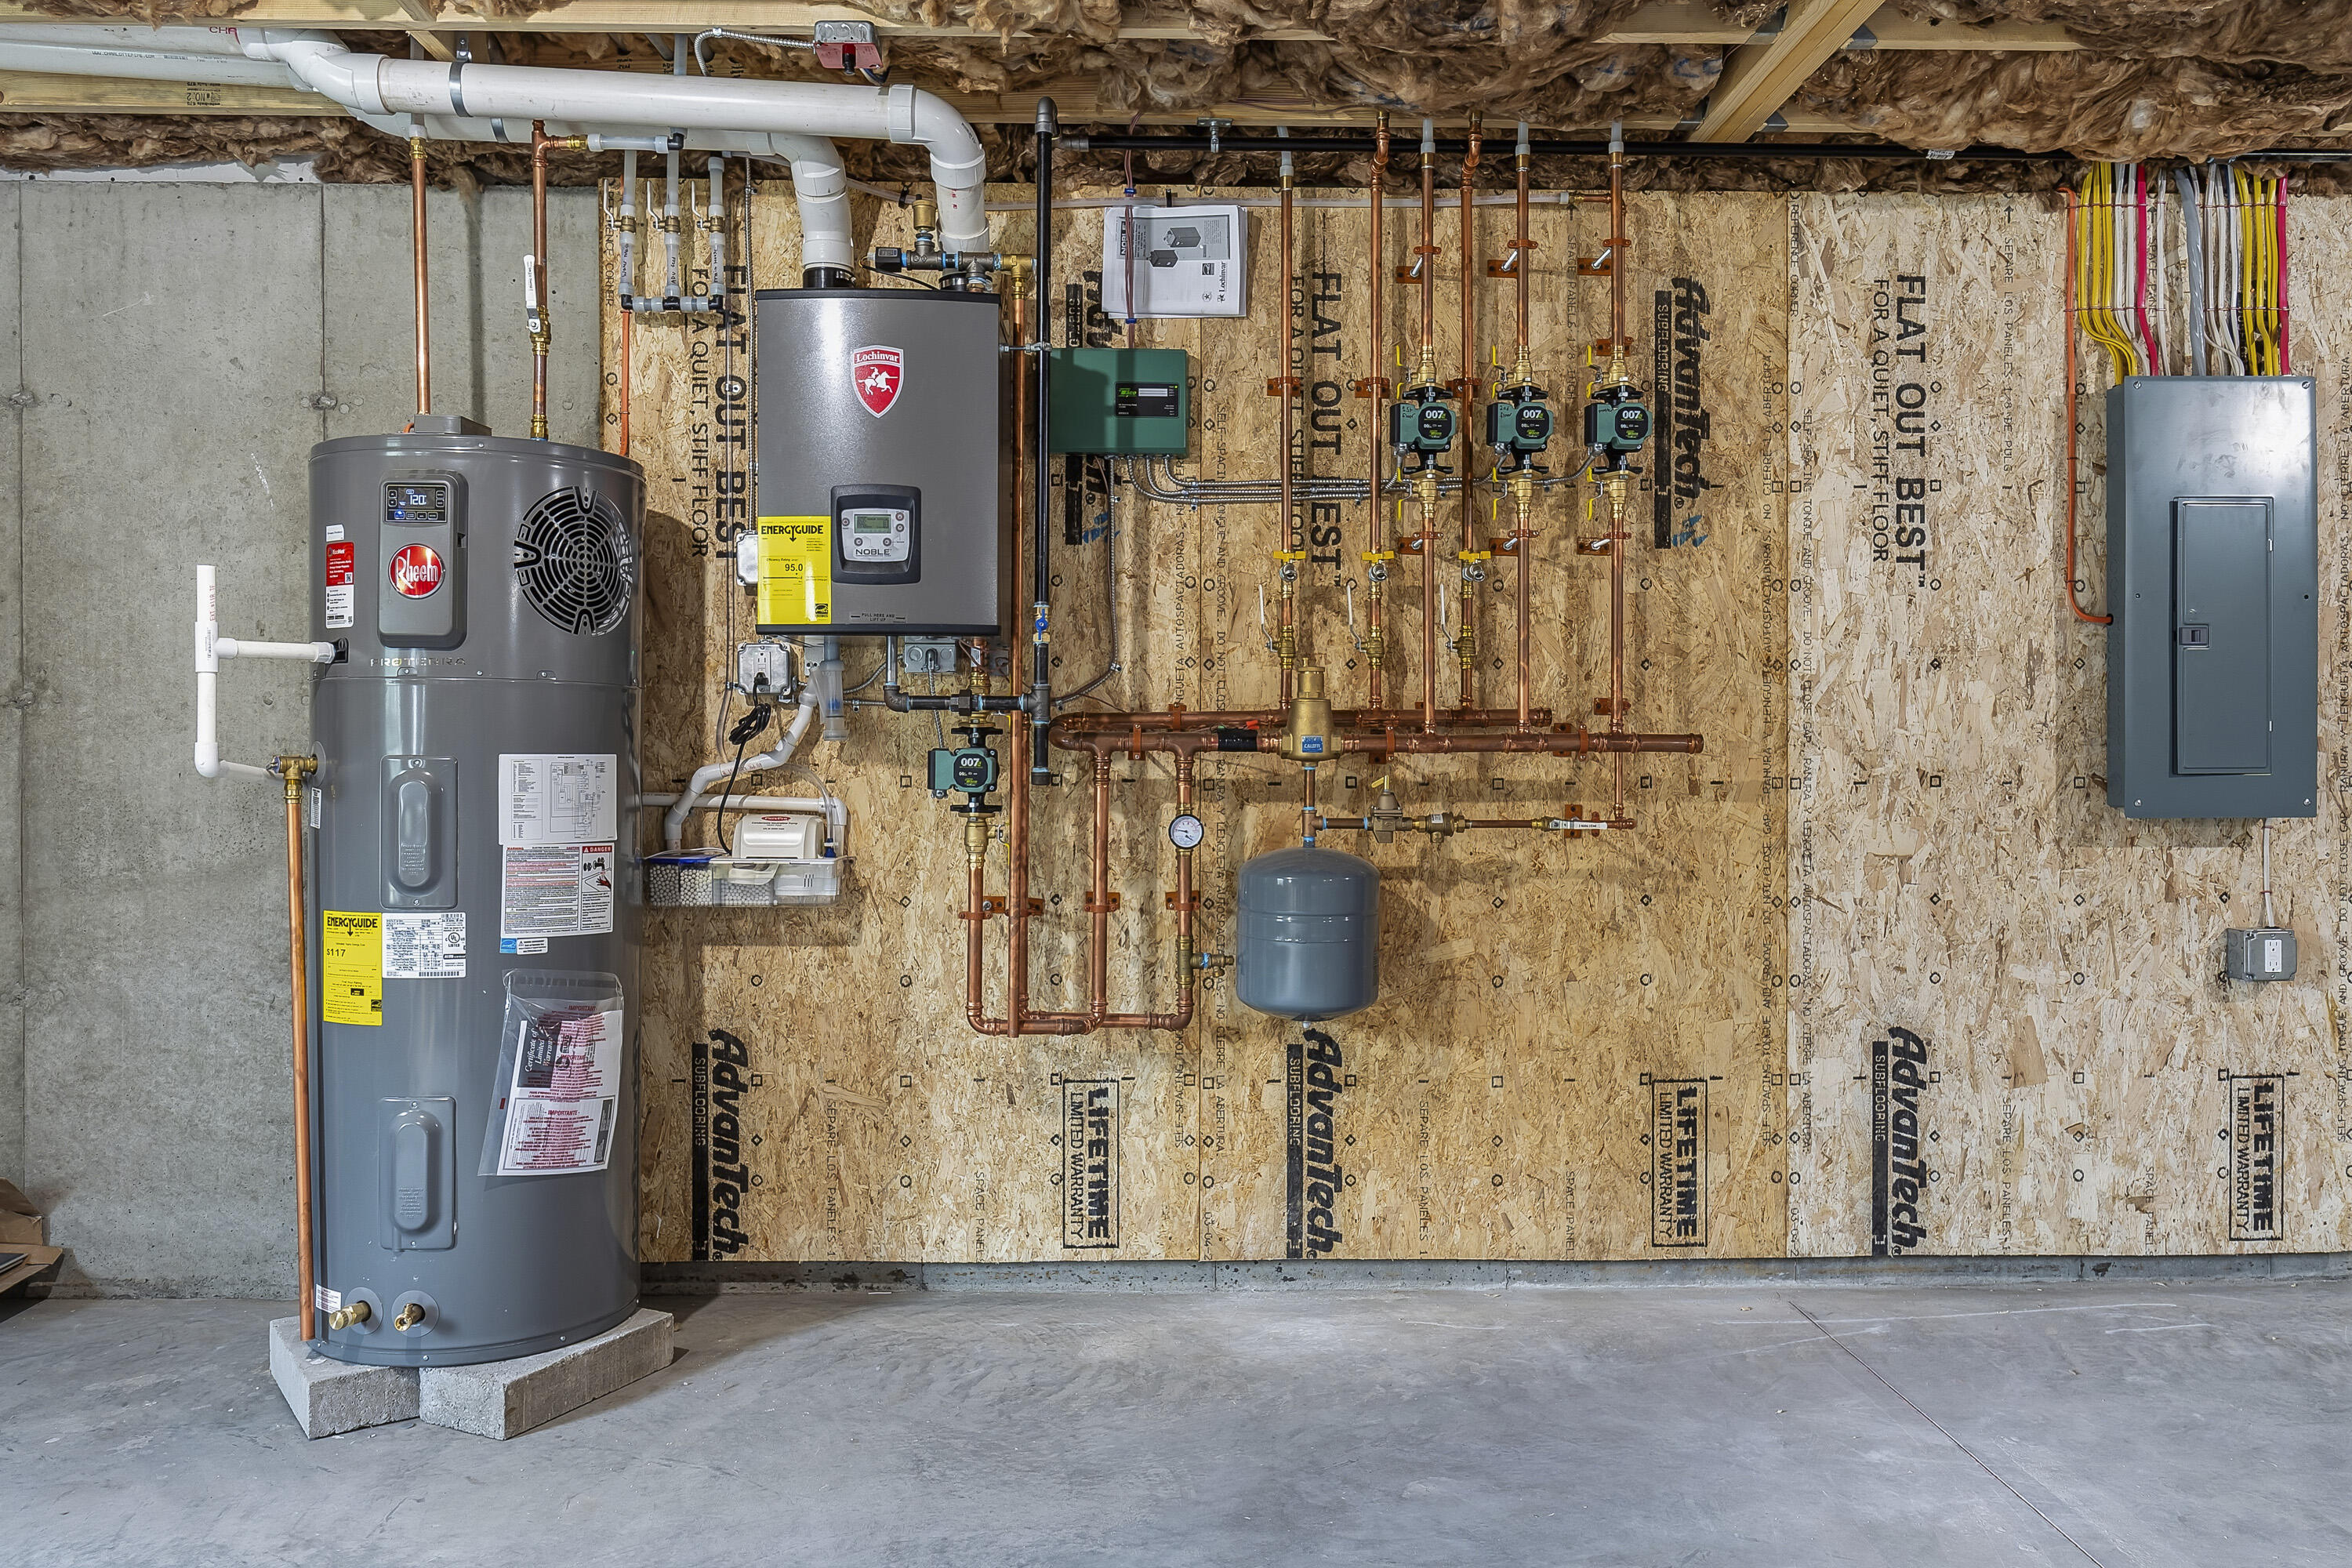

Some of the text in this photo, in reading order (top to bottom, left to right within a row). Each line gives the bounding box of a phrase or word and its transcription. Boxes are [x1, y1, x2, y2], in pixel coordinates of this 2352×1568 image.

[187, 93, 191, 102] 2
[1567, 235, 1577, 271] SPACE
[1790, 204, 1799, 268] REFERENCE
[2148, 237, 2157, 276] SPACE
[1218, 261, 1227, 292] Lochinvar
[2002, 237, 2013, 283] SEPARE
[604, 263, 614, 307] CORNER
[2002, 292, 2013, 315] LOS
[856, 351, 899, 362] Lochinvar
[1311, 271, 1342, 458] FLAT OUT
[1656, 304, 1670, 392] SUBFLOORING
[1895, 274, 1926, 458] FLAT OUT
[2002, 323, 2013, 378] PANELES
[1567, 370, 1577, 399] INCH
[715, 376, 746, 450] OUT
[1871, 279, 1889, 563] FOR A QUIET, STIFF FLOOR
[2002, 417, 2013, 433] DE
[690, 318, 708, 558] A QUIET, STIFF FLOOR
[1217, 406, 1226, 481] SELF-SPACIN
[2002, 441, 2013, 472] PULG
[1762, 450, 1772, 495] CIERRE
[2339, 450, 2349, 495] CIERRE
[760, 525, 824, 535] ENERGYGUIDE
[1217, 504, 1226, 540] ONGUE
[1762, 504, 1772, 519] NO
[1803, 500, 1812, 541] TONGUE
[2339, 503, 2349, 519] NO
[395, 549, 438, 590] Rheem
[785, 563, 803, 572] 95.0
[1217, 547, 1226, 569] AND
[1803, 548, 1812, 569] AND
[1217, 630, 1226, 646] DO
[1803, 630, 1812, 646] DO
[1217, 652, 1226, 673] NOT
[1803, 652, 1812, 673] NOT
[1762, 658, 1772, 723] LENGUETA
[1803, 681, 1812, 716] CLOSE
[2339, 662, 2349, 723] LENGUETA
[1762, 747, 1772, 794] RANURA
[1803, 758, 1812, 800] RANURA
[2339, 746, 2349, 792] RANURA
[1762, 844, 1772, 877] CLOSE
[1803, 821, 1812, 877] LENGUETA
[2339, 839, 2349, 873] CLOSE
[1762, 883, 1772, 905] NOT
[2339, 883, 2349, 902] NOT
[327, 916, 378, 928] ENERGYGUIDE
[1217, 759, 1225, 1069] RANURA LENGUETA NO CIERRE
[1762, 911, 1772, 925] DO
[2339, 908, 2349, 922] DO
[1762, 988, 1772, 1008] AND
[1803, 1002, 1812, 1017] NO
[2338, 983, 2347, 1005] AND
[524, 1028, 538, 1072] Certificate of
[535, 1038, 545, 1065] Limited
[1762, 1016, 1772, 1057] TONGUE
[1803, 1022, 1812, 1066] CIERRE
[2338, 1011, 2347, 1052] TONGUE
[695, 1058, 706, 1146] SUBFLOORING
[1174, 1064, 1184, 1148] SELF-SPACING
[1289, 1058, 1301, 1146] SUBFLOORING
[1874, 1054, 1886, 1142] SUBFLOORING
[2338, 1060, 2347, 1142] SELF-SPACING
[827, 1101, 836, 1242] SEPARE LOS PANELES
[1069, 1091, 1084, 1240] LIMITED WARRANTY
[1087, 1087, 1109, 1239] LIFETIME
[1419, 1101, 1428, 1241] SEPARE LOS PANELES
[1658, 1091, 1673, 1239] LIMITED WARRANTY
[1676, 1087, 1697, 1237] LIFETIME
[2002, 1097, 2012, 1236] SEPARE LOS PANELES
[2237, 1087, 2250, 1232] LIMITED WARRANTY
[2253, 1082, 2274, 1232] LIFETIME
[975, 1171, 985, 1210] SPACE
[2145, 1167, 2154, 1203] SPACE
